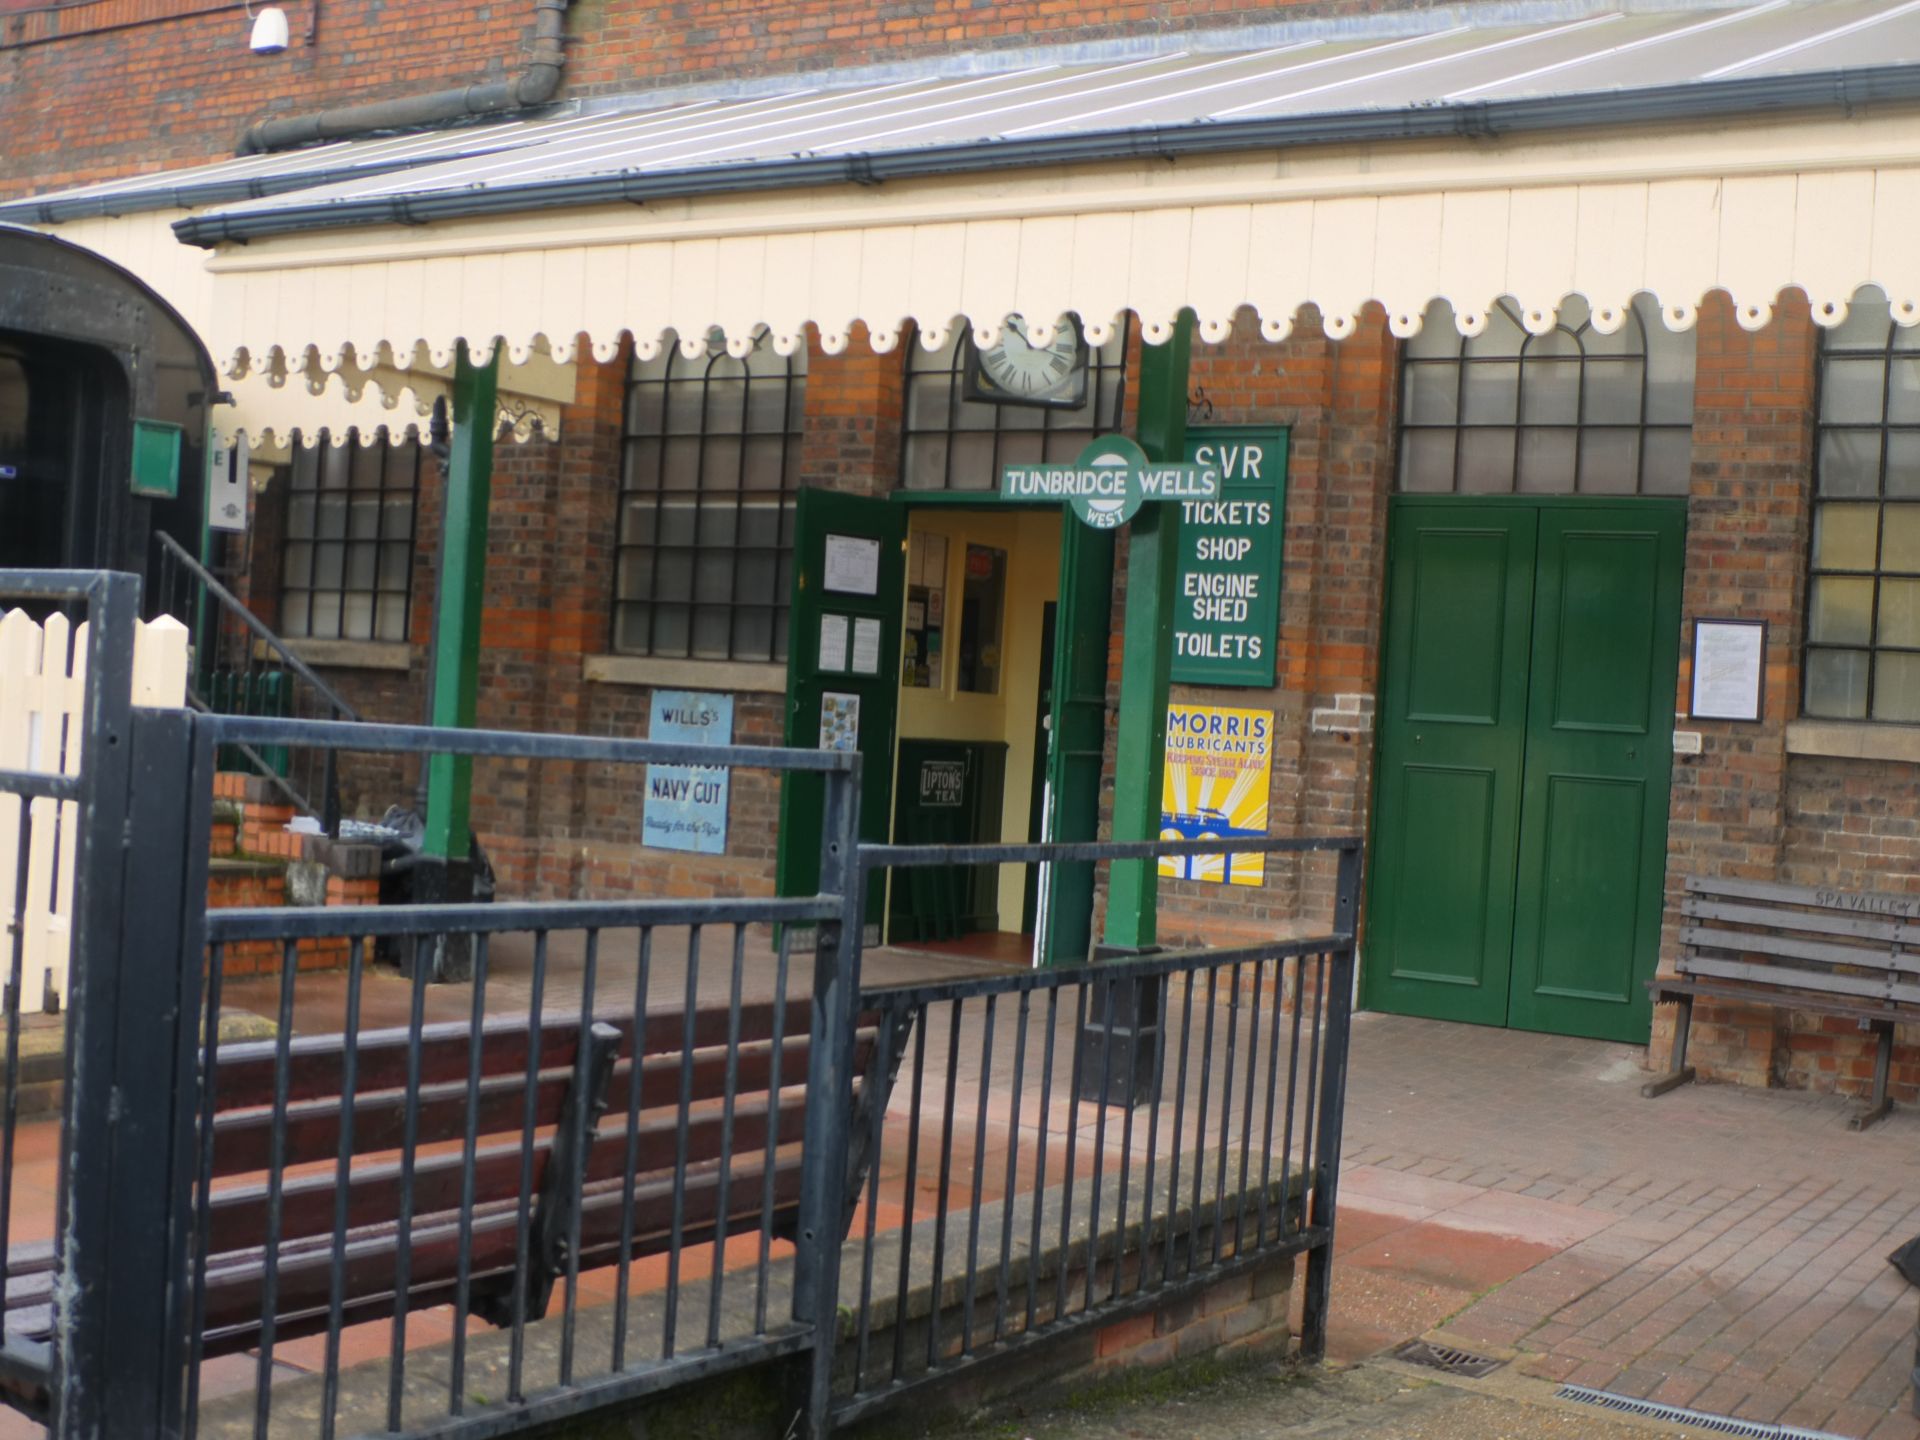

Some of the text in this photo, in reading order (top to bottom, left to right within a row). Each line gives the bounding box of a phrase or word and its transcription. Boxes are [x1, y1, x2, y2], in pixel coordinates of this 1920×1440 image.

[1007, 471, 1216, 495] TUNBRIDGE WELLS
[1086, 508, 1124, 528] WEST
[1181, 501, 1271, 525] TICKETS
[1196, 538, 1252, 561] SHOP
[1184, 573, 1259, 598] ENGINE
[1192, 598, 1248, 622] SHED
[1175, 632, 1262, 659] TOILETS
[1168, 711, 1266, 738] MORRIS
[1167, 735, 1265, 754] LUBRICANTS
[652, 778, 721, 805] NAVY CUT
[922, 768, 961, 796] LIPTON'S
[936, 790, 955, 801] TEA
[1815, 891, 1843, 908] SPA
[1850, 895, 1911, 917] VALLEY
